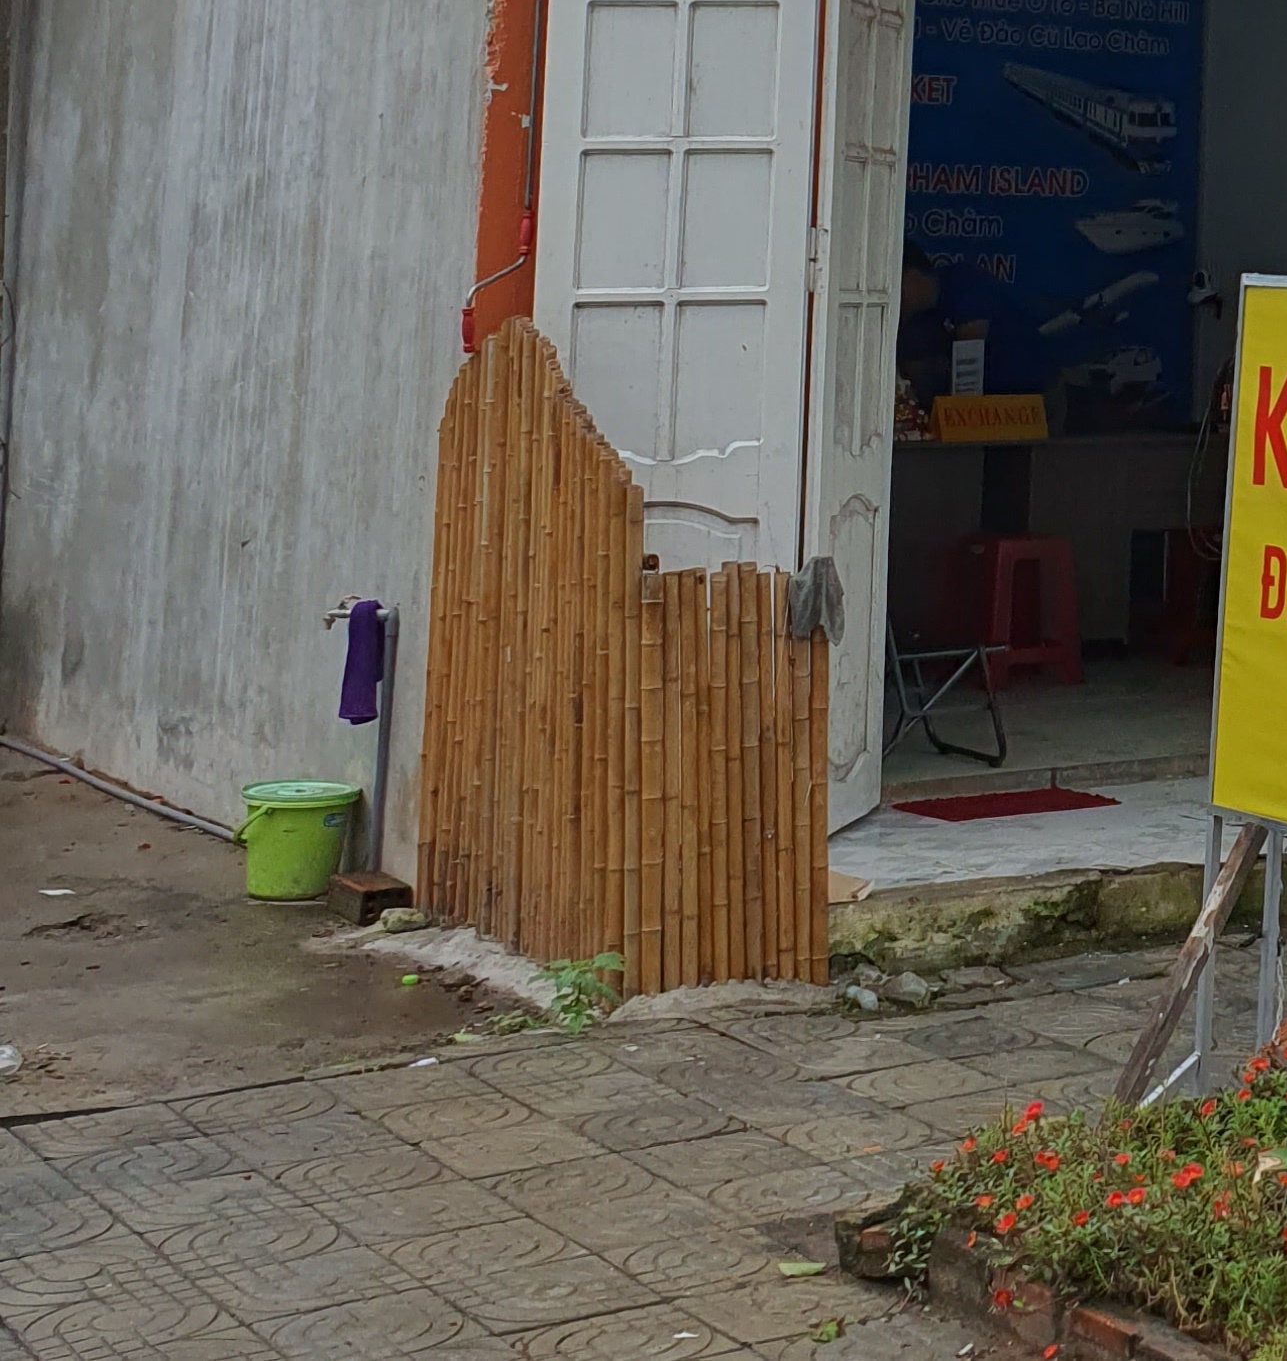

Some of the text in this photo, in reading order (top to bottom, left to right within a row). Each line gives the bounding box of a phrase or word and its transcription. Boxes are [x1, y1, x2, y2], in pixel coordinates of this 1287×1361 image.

[1158, 0, 1191, 24] Hill
[1063, 26, 1104, 52] Lao
[909, 162, 1089, 198] HAM ISLAND
[942, 404, 1042, 429] EXCHANGE
